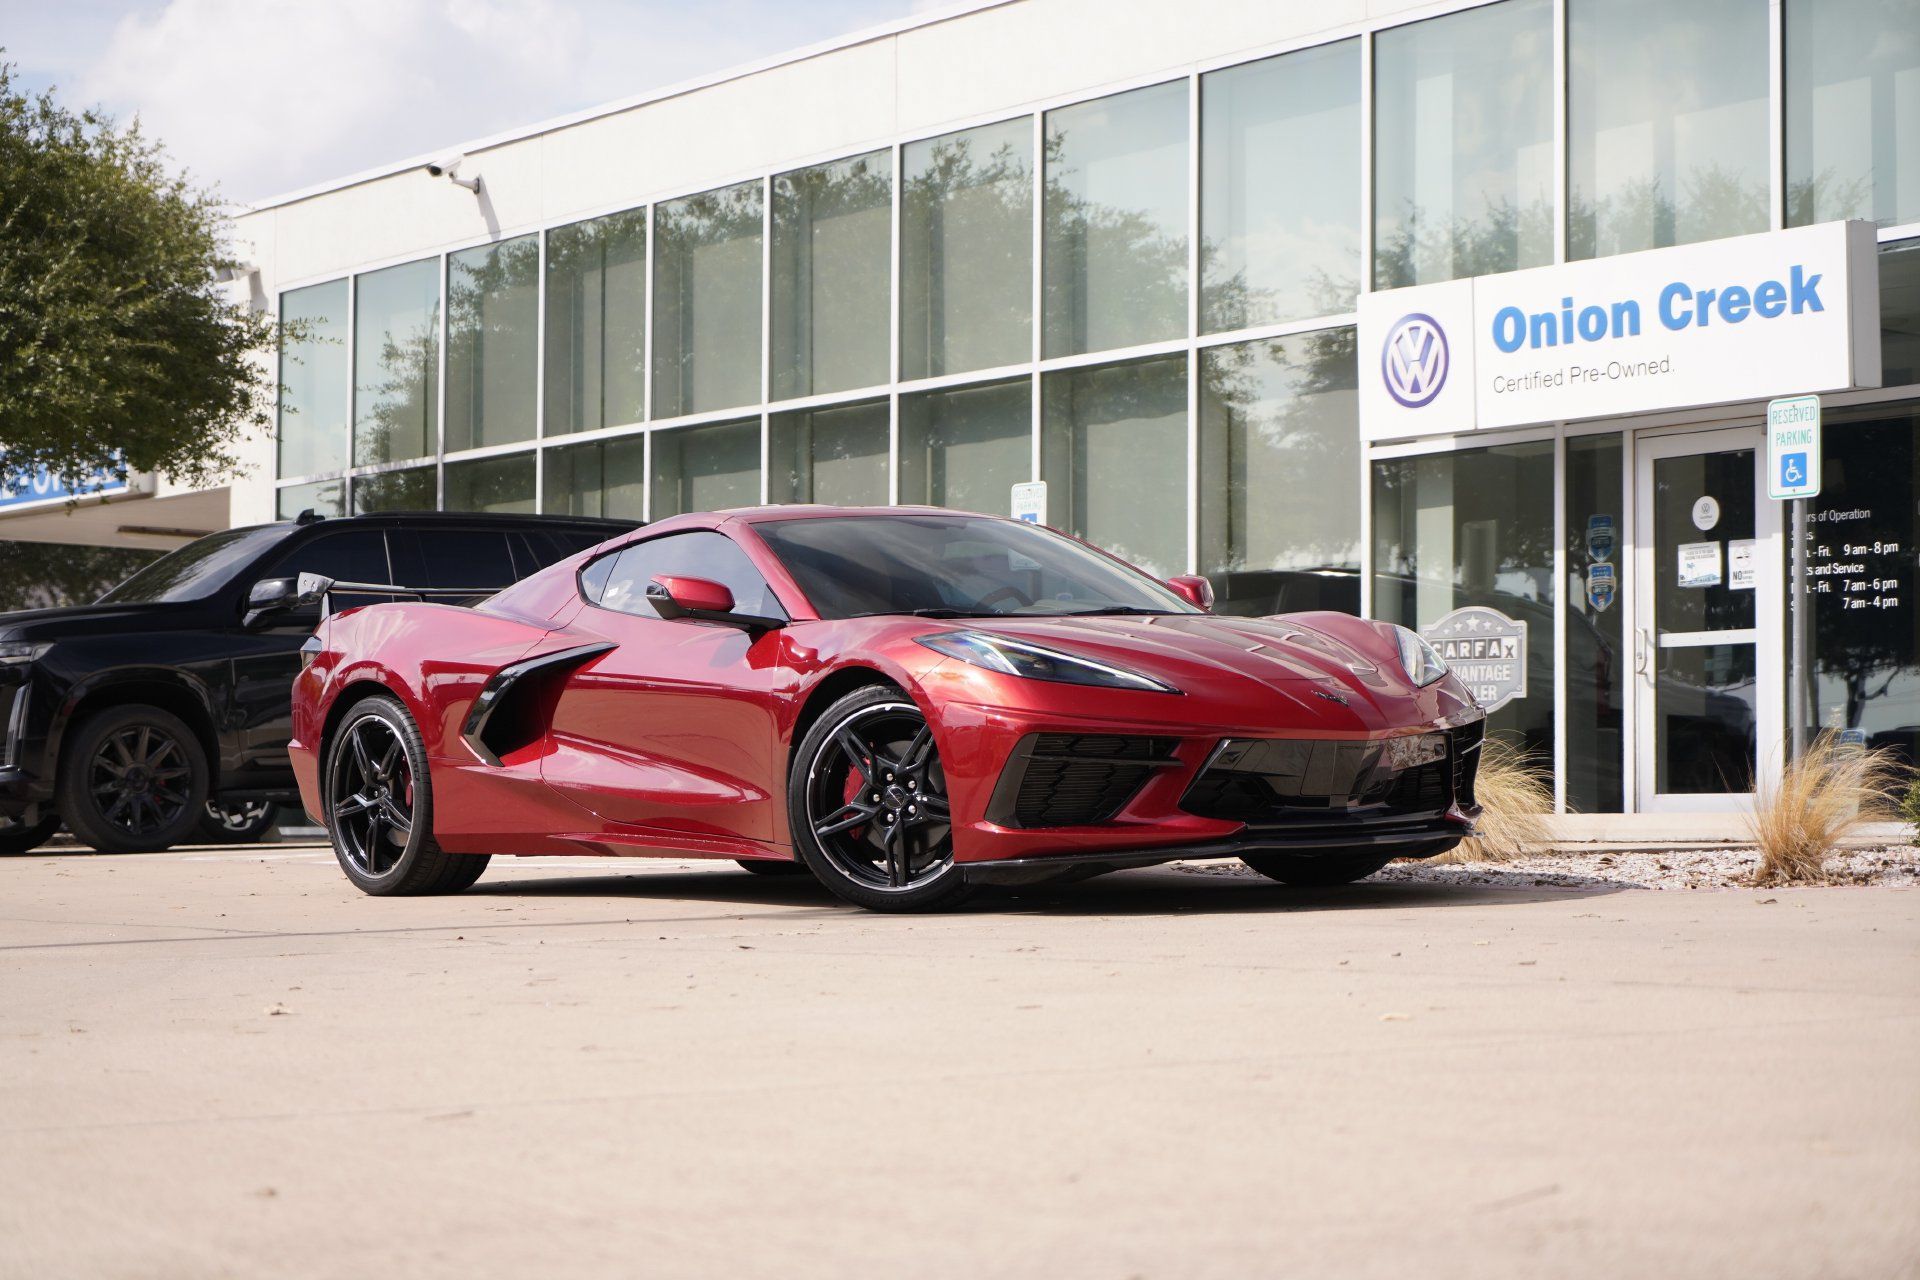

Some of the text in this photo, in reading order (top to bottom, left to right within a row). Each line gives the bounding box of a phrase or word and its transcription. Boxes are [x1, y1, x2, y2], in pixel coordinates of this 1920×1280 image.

[1492, 264, 1825, 353] Onion Creek
[1383, 315, 1448, 406] VW
[1493, 369, 1565, 394] Certified
[1772, 406, 1816, 424] RESERVED
[1776, 429, 1812, 446] PARKING
[1818, 511, 1827, 522] of
[1829, 509, 1871, 523] Operation
[1818, 545, 1831, 557] Fri.
[1843, 544, 1850, 556] 9
[1852, 545, 1867, 555] am
[1874, 541, 1881, 554] 8
[1883, 542, 1898, 555] pm
[1732, 570, 1742, 580] NO
[1815, 563, 1831, 575] and
[1832, 562, 1864, 574] Service
[1818, 581, 1831, 593] Fri.
[1843, 580, 1850, 592] 7
[1851, 581, 1866, 592] am
[1873, 578, 1880, 590] 6
[1882, 579, 1897, 592] pm
[1843, 598, 1850, 609] 7
[1851, 599, 1865, 609] am
[1873, 596, 1880, 607] 4
[1882, 597, 1898, 609] pm
[1452, 664, 1511, 681] VANTAGE
